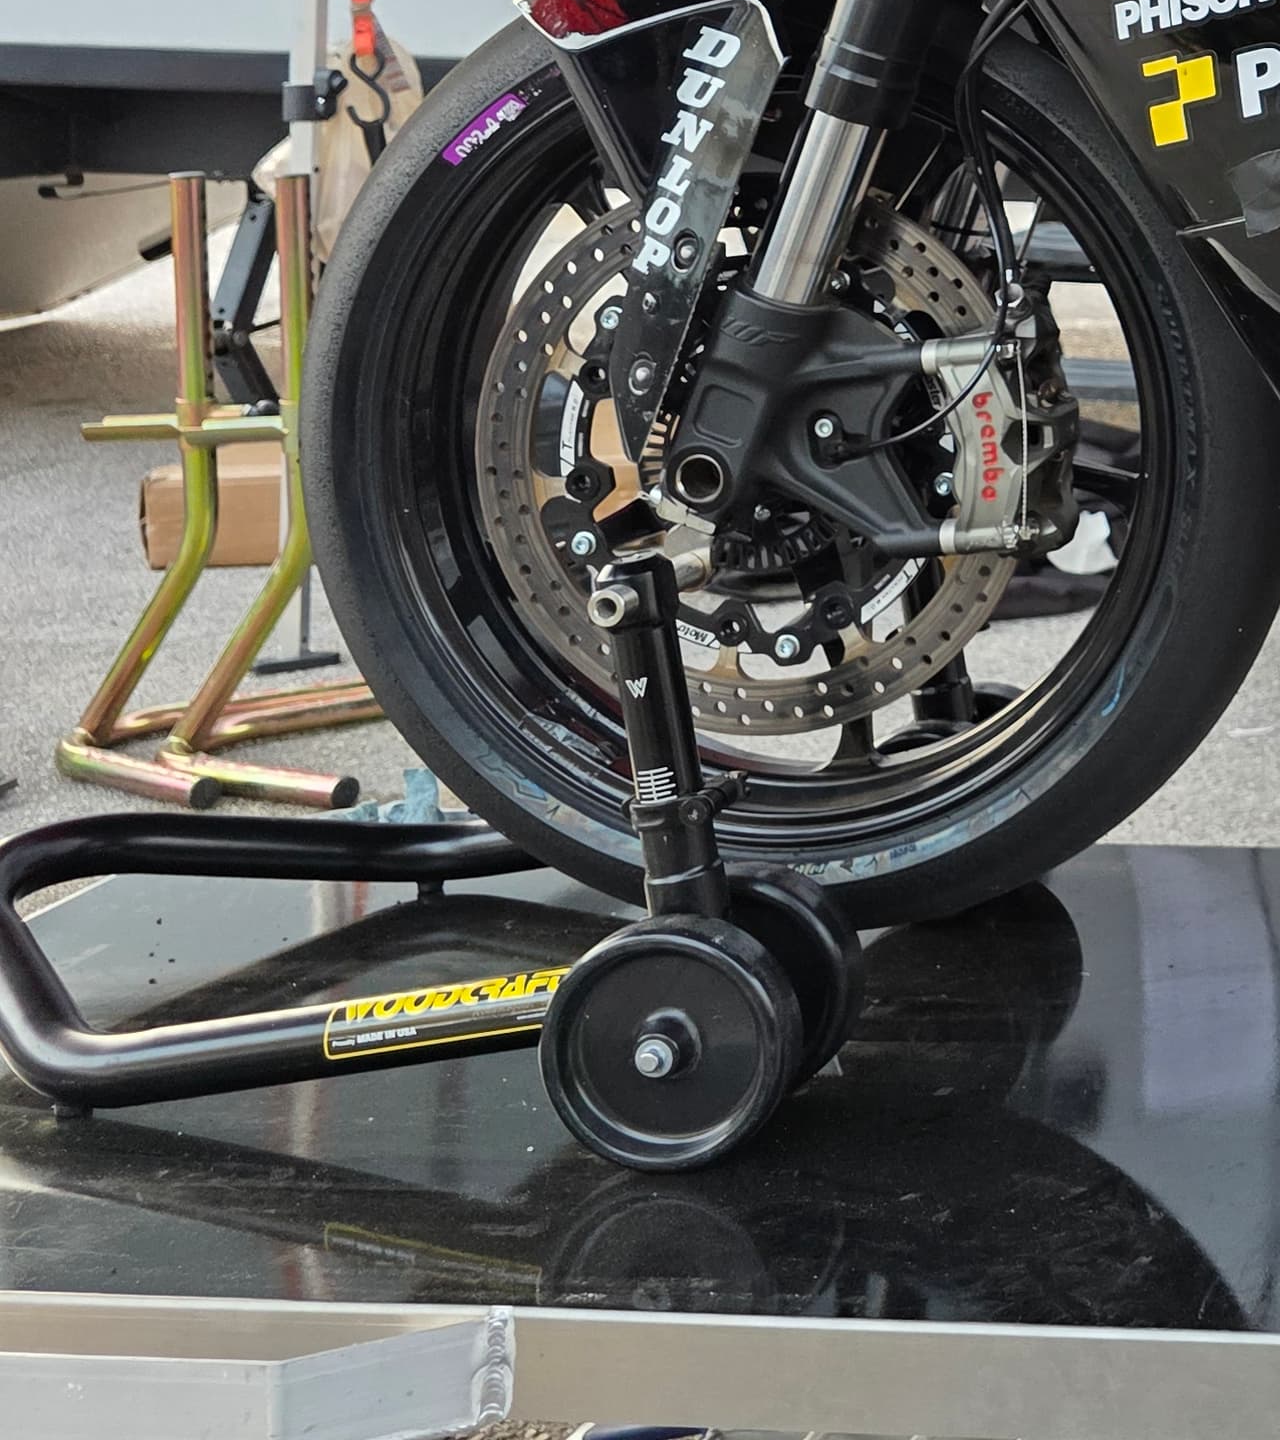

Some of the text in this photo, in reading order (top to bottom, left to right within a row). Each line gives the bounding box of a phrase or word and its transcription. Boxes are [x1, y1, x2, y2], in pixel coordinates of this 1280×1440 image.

[632, 25, 741, 276] DUNLOP
[971, 390, 1006, 503] brembo
[345, 966, 572, 1023] WOODCRAFT
